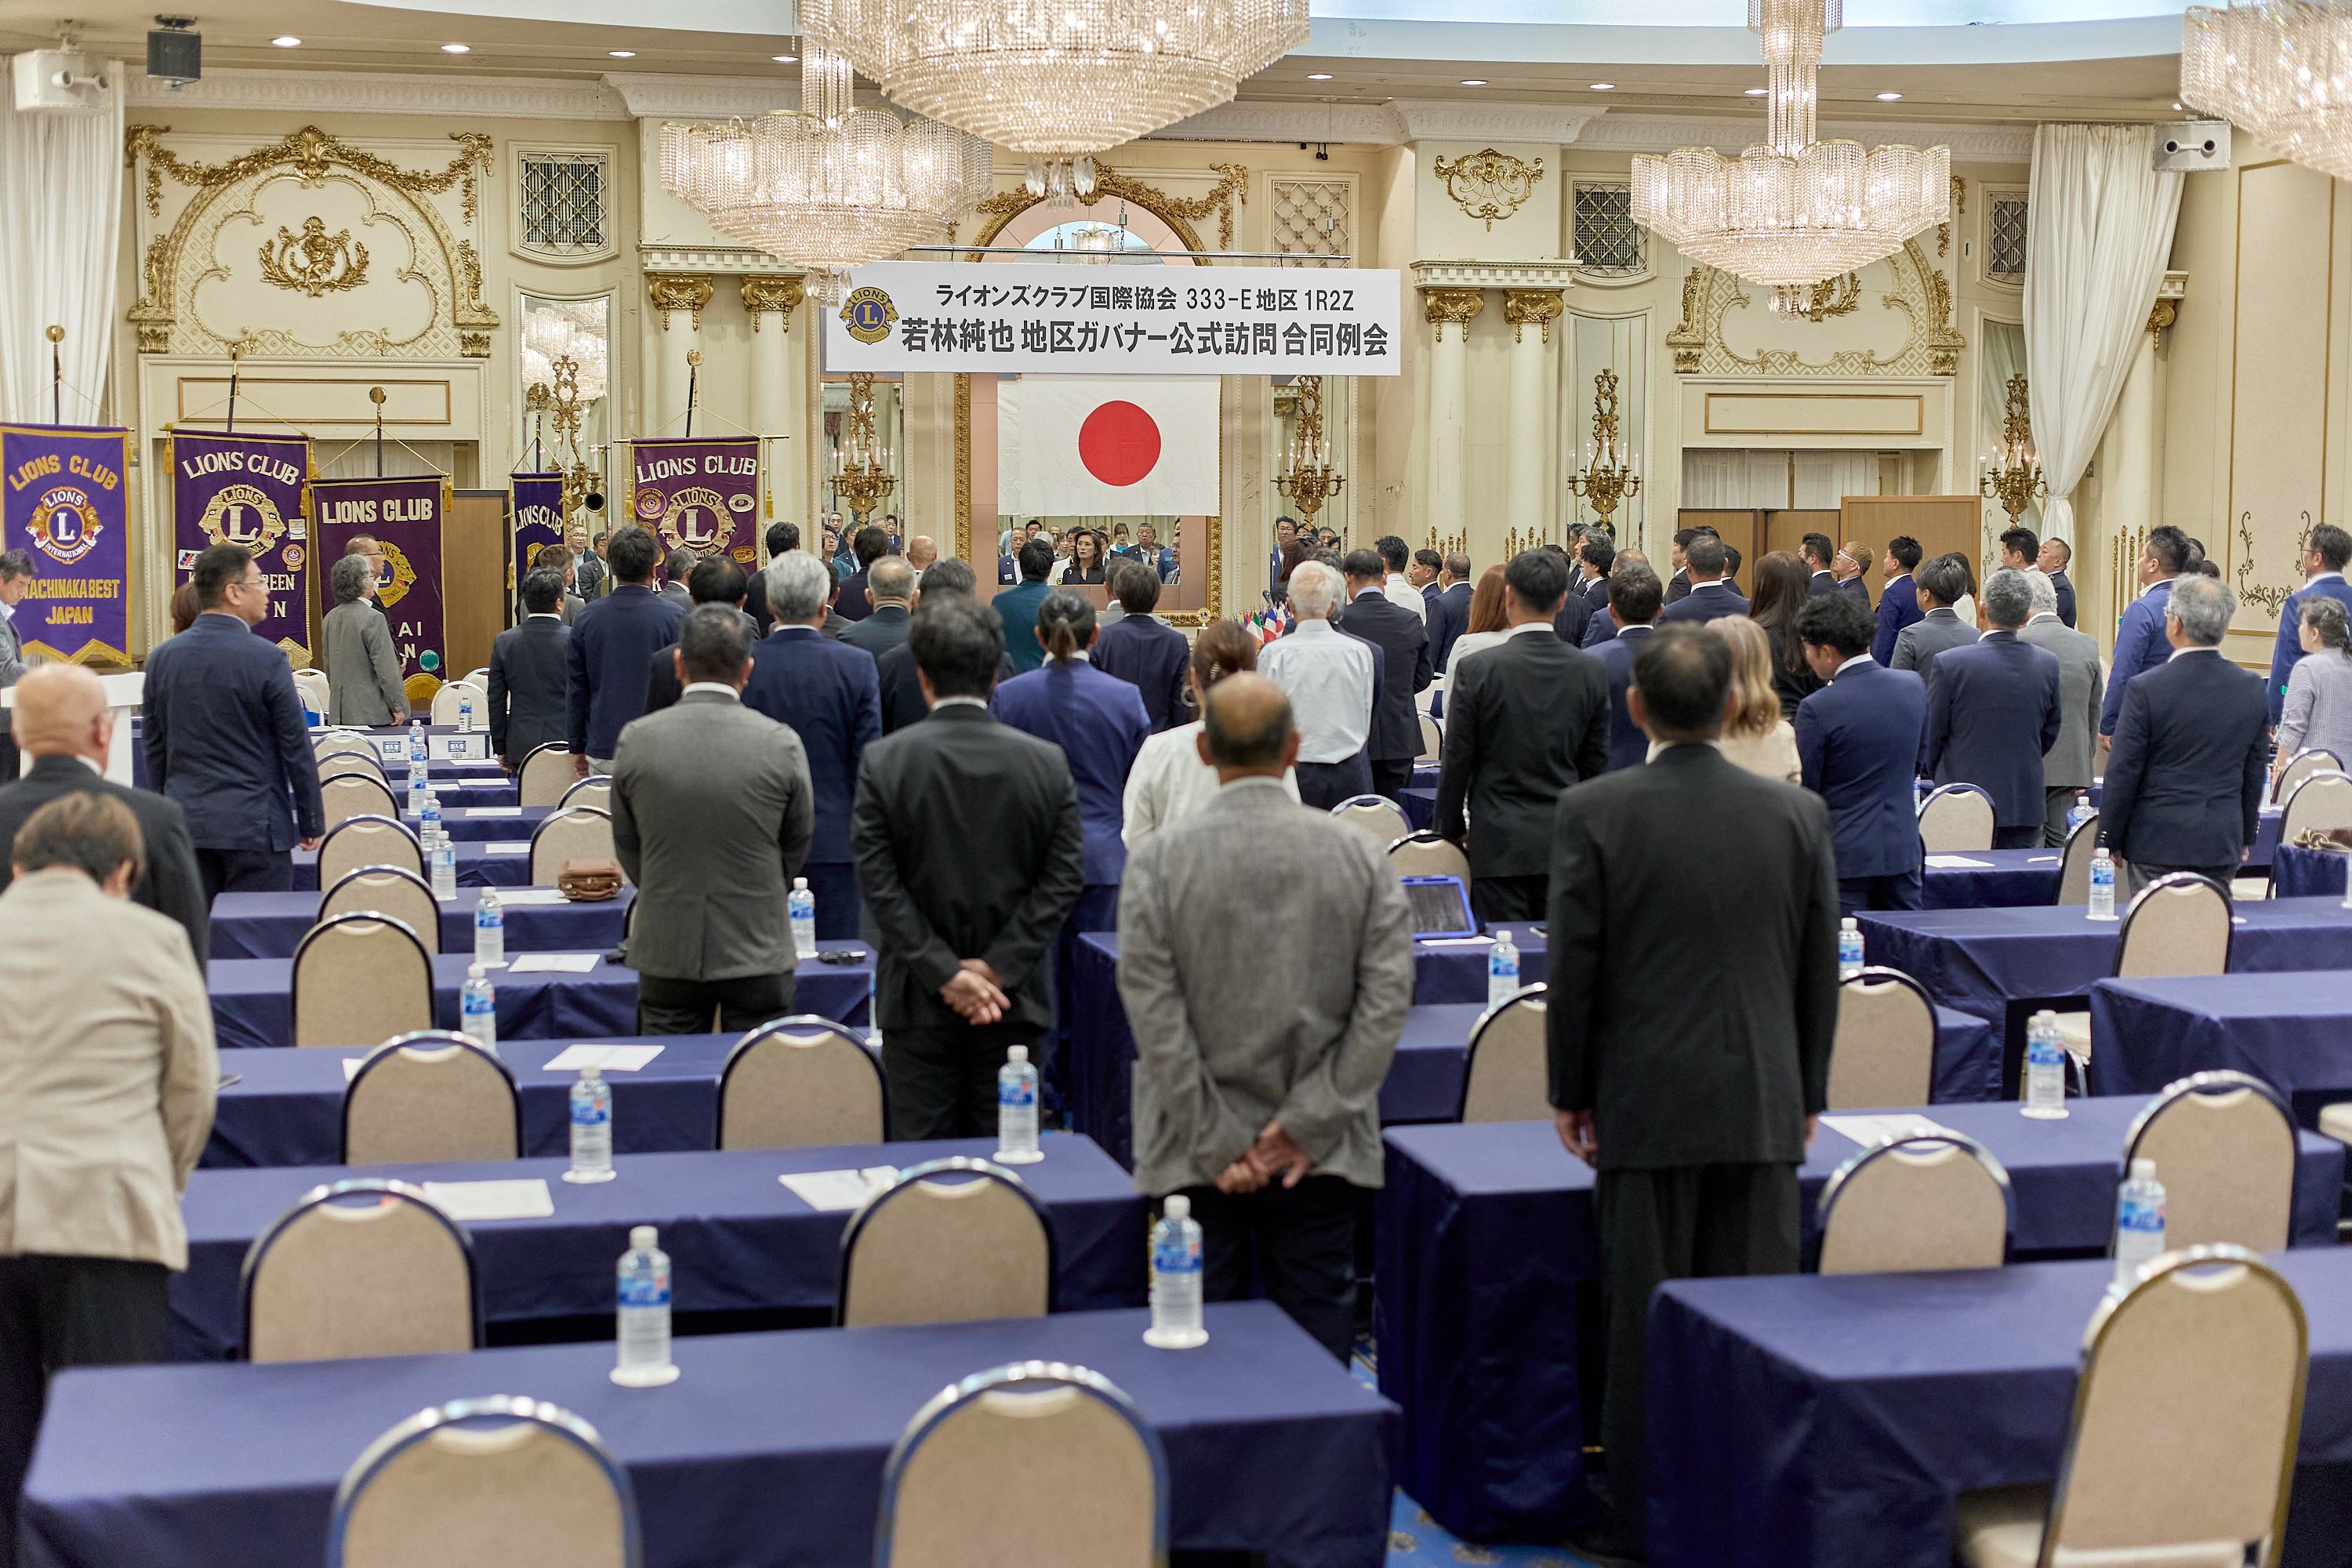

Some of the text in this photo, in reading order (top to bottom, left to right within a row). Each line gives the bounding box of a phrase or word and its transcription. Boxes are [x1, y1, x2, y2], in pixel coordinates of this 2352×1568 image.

[852, 289, 887, 302] LIONS
[936, 285, 1177, 310] ライオンズクラブ国際協会
[1305, 289, 1354, 311] 1R2Z
[862, 304, 878, 325] L
[852, 328, 887, 340] INTERNATIONAL
[9, 455, 119, 492] LIONS CLUB
[182, 451, 299, 486] LIONS CLUB
[636, 455, 757, 484] LIONS CLUB
[44, 490, 84, 508] LIONS
[223, 488, 263, 505] LIONS
[676, 489, 719, 507] LIONS
[321, 498, 434, 524] LIONS CLUB
[56, 512, 75, 541] L
[227, 505, 259, 541] L
[684, 509, 714, 542] L
[45, 543, 89, 558] INTERNATIONAL
[45, 606, 93, 625] JAPAN
